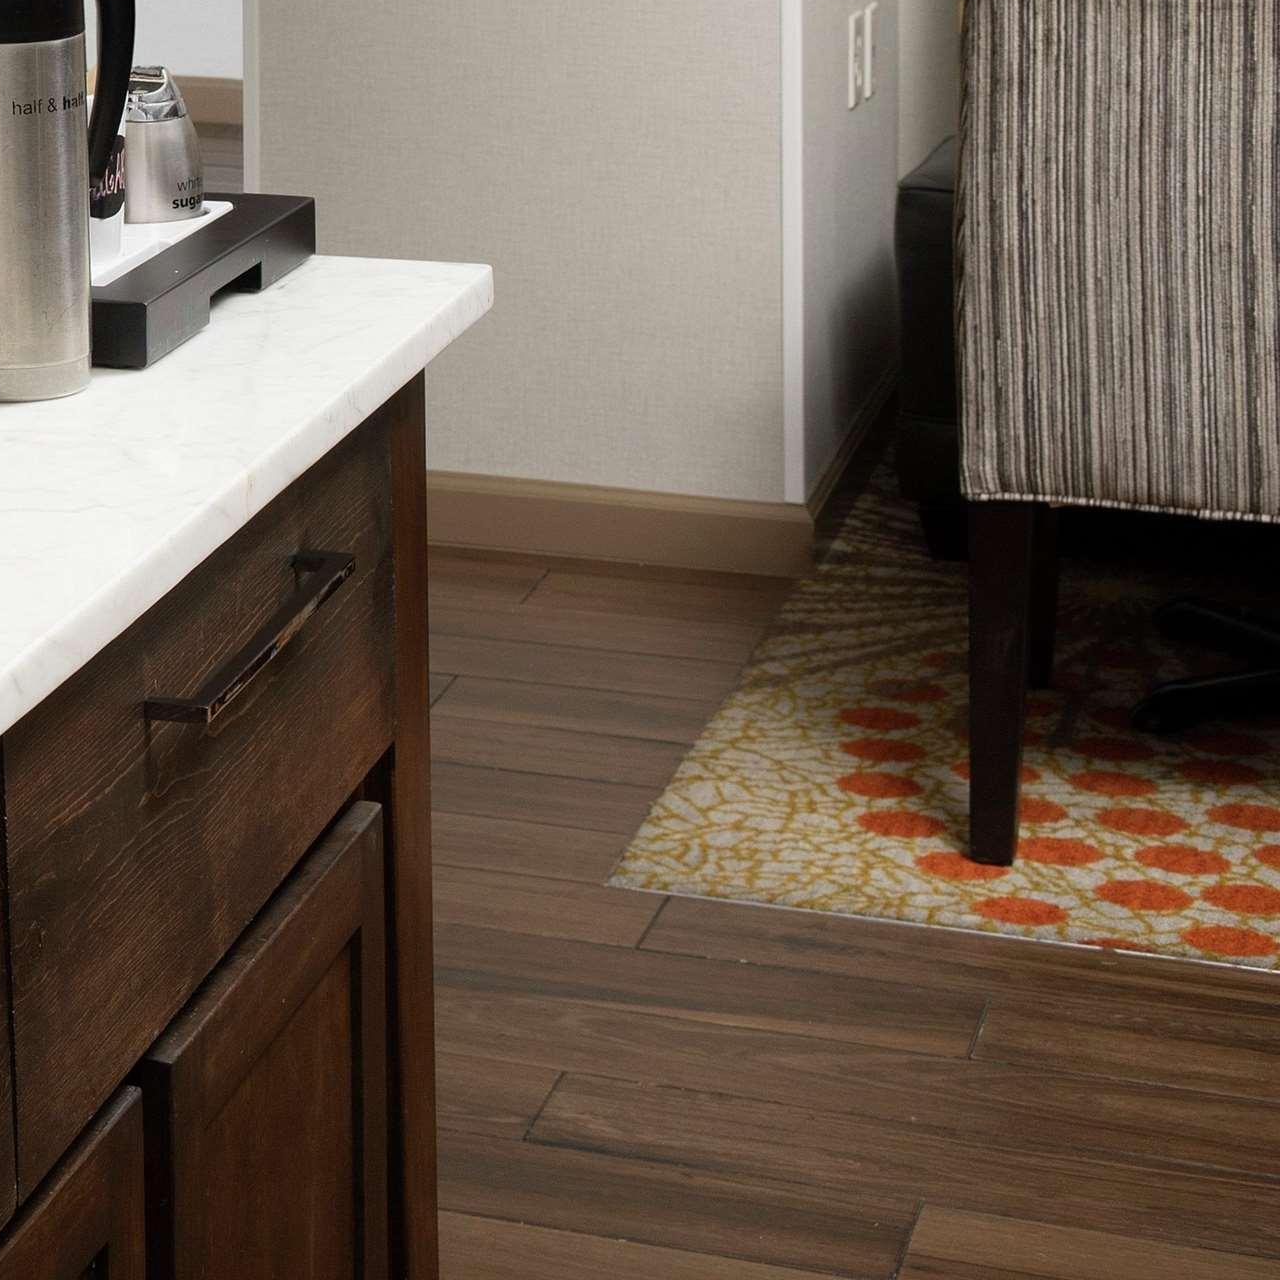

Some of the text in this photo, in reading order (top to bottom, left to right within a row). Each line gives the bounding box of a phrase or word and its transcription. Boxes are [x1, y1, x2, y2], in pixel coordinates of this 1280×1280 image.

[11, 98, 43, 116] half
[47, 97, 58, 113] &
[177, 177, 203, 192] whit
[172, 194, 203, 210] suga
